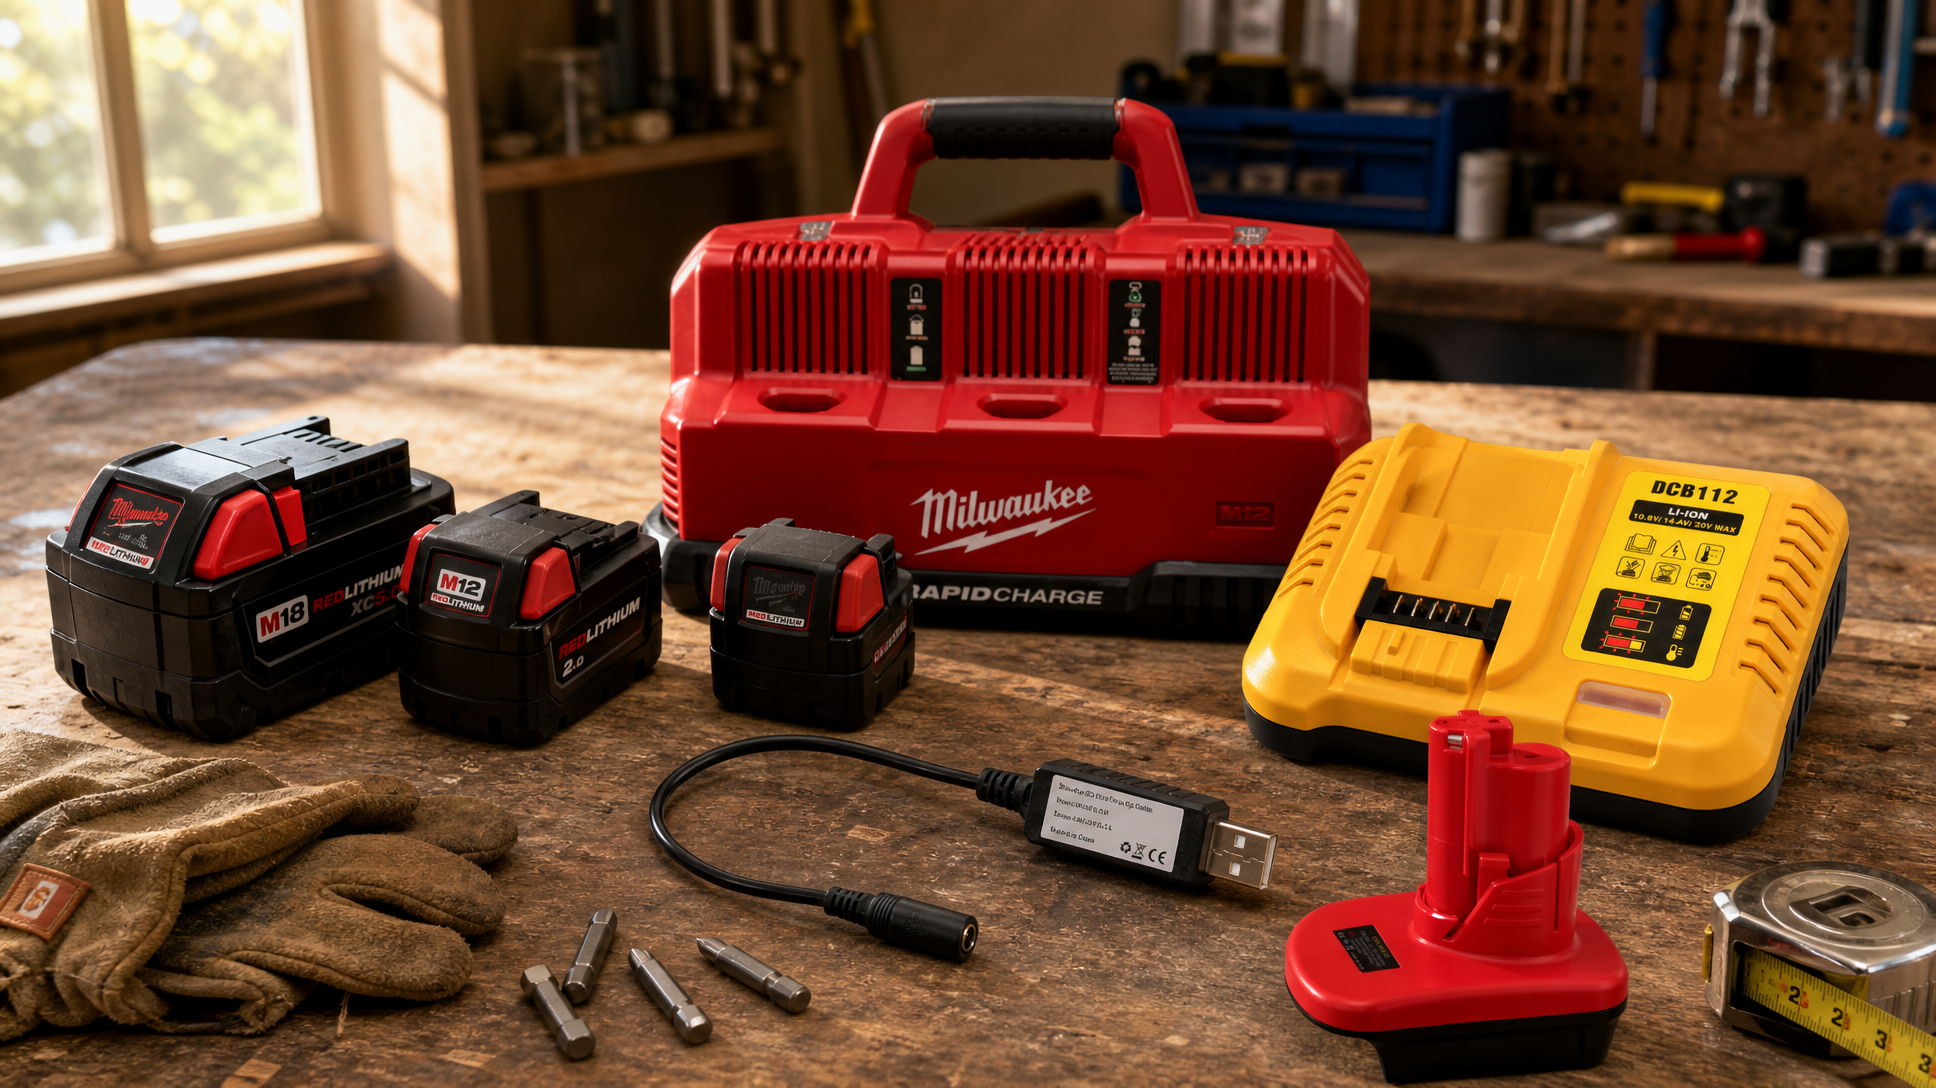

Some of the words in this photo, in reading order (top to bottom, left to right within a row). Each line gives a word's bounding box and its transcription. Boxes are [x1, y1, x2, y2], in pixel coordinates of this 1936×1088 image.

[1651, 480, 1739, 504] DCB112
[909, 480, 1094, 539] Milwaukee
[1221, 506, 1271, 521] M12
[1668, 507, 1709, 520] LI-ION
[440, 573, 482, 597] M12
[259, 601, 305, 638] M18
[558, 596, 641, 660] REDLITHIUM
[562, 655, 585, 678] 2.0
